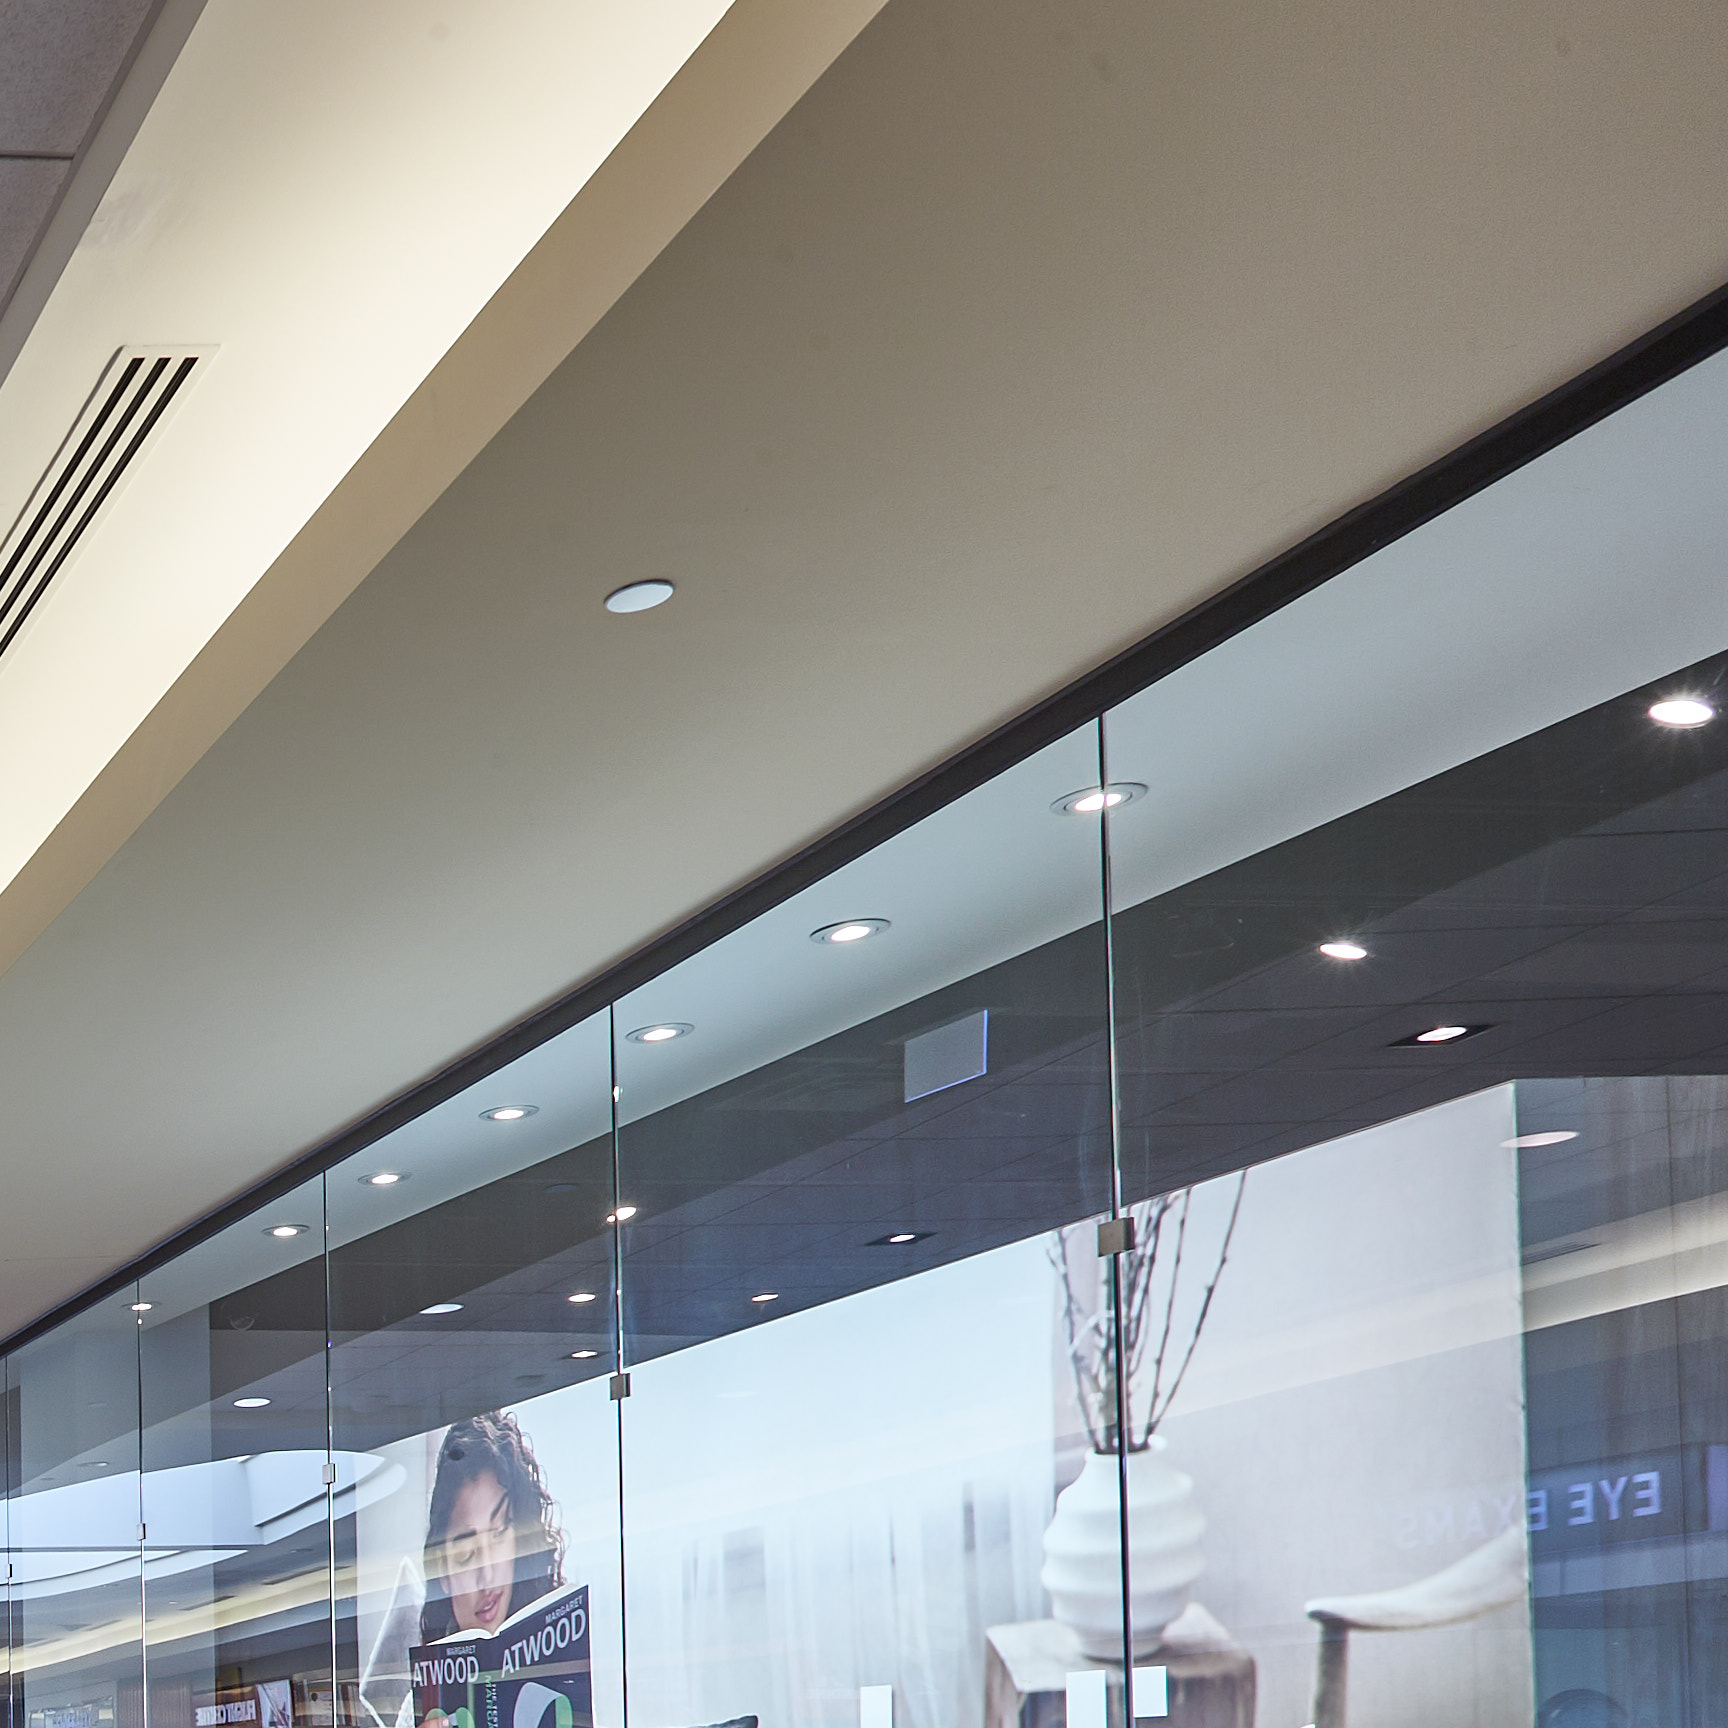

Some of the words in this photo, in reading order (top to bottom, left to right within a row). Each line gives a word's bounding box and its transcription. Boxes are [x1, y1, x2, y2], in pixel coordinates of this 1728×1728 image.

[544, 1594, 585, 1625] MARGARET
[500, 1608, 587, 1679] ATWOOD
[413, 1656, 480, 1689] ATWOOD
